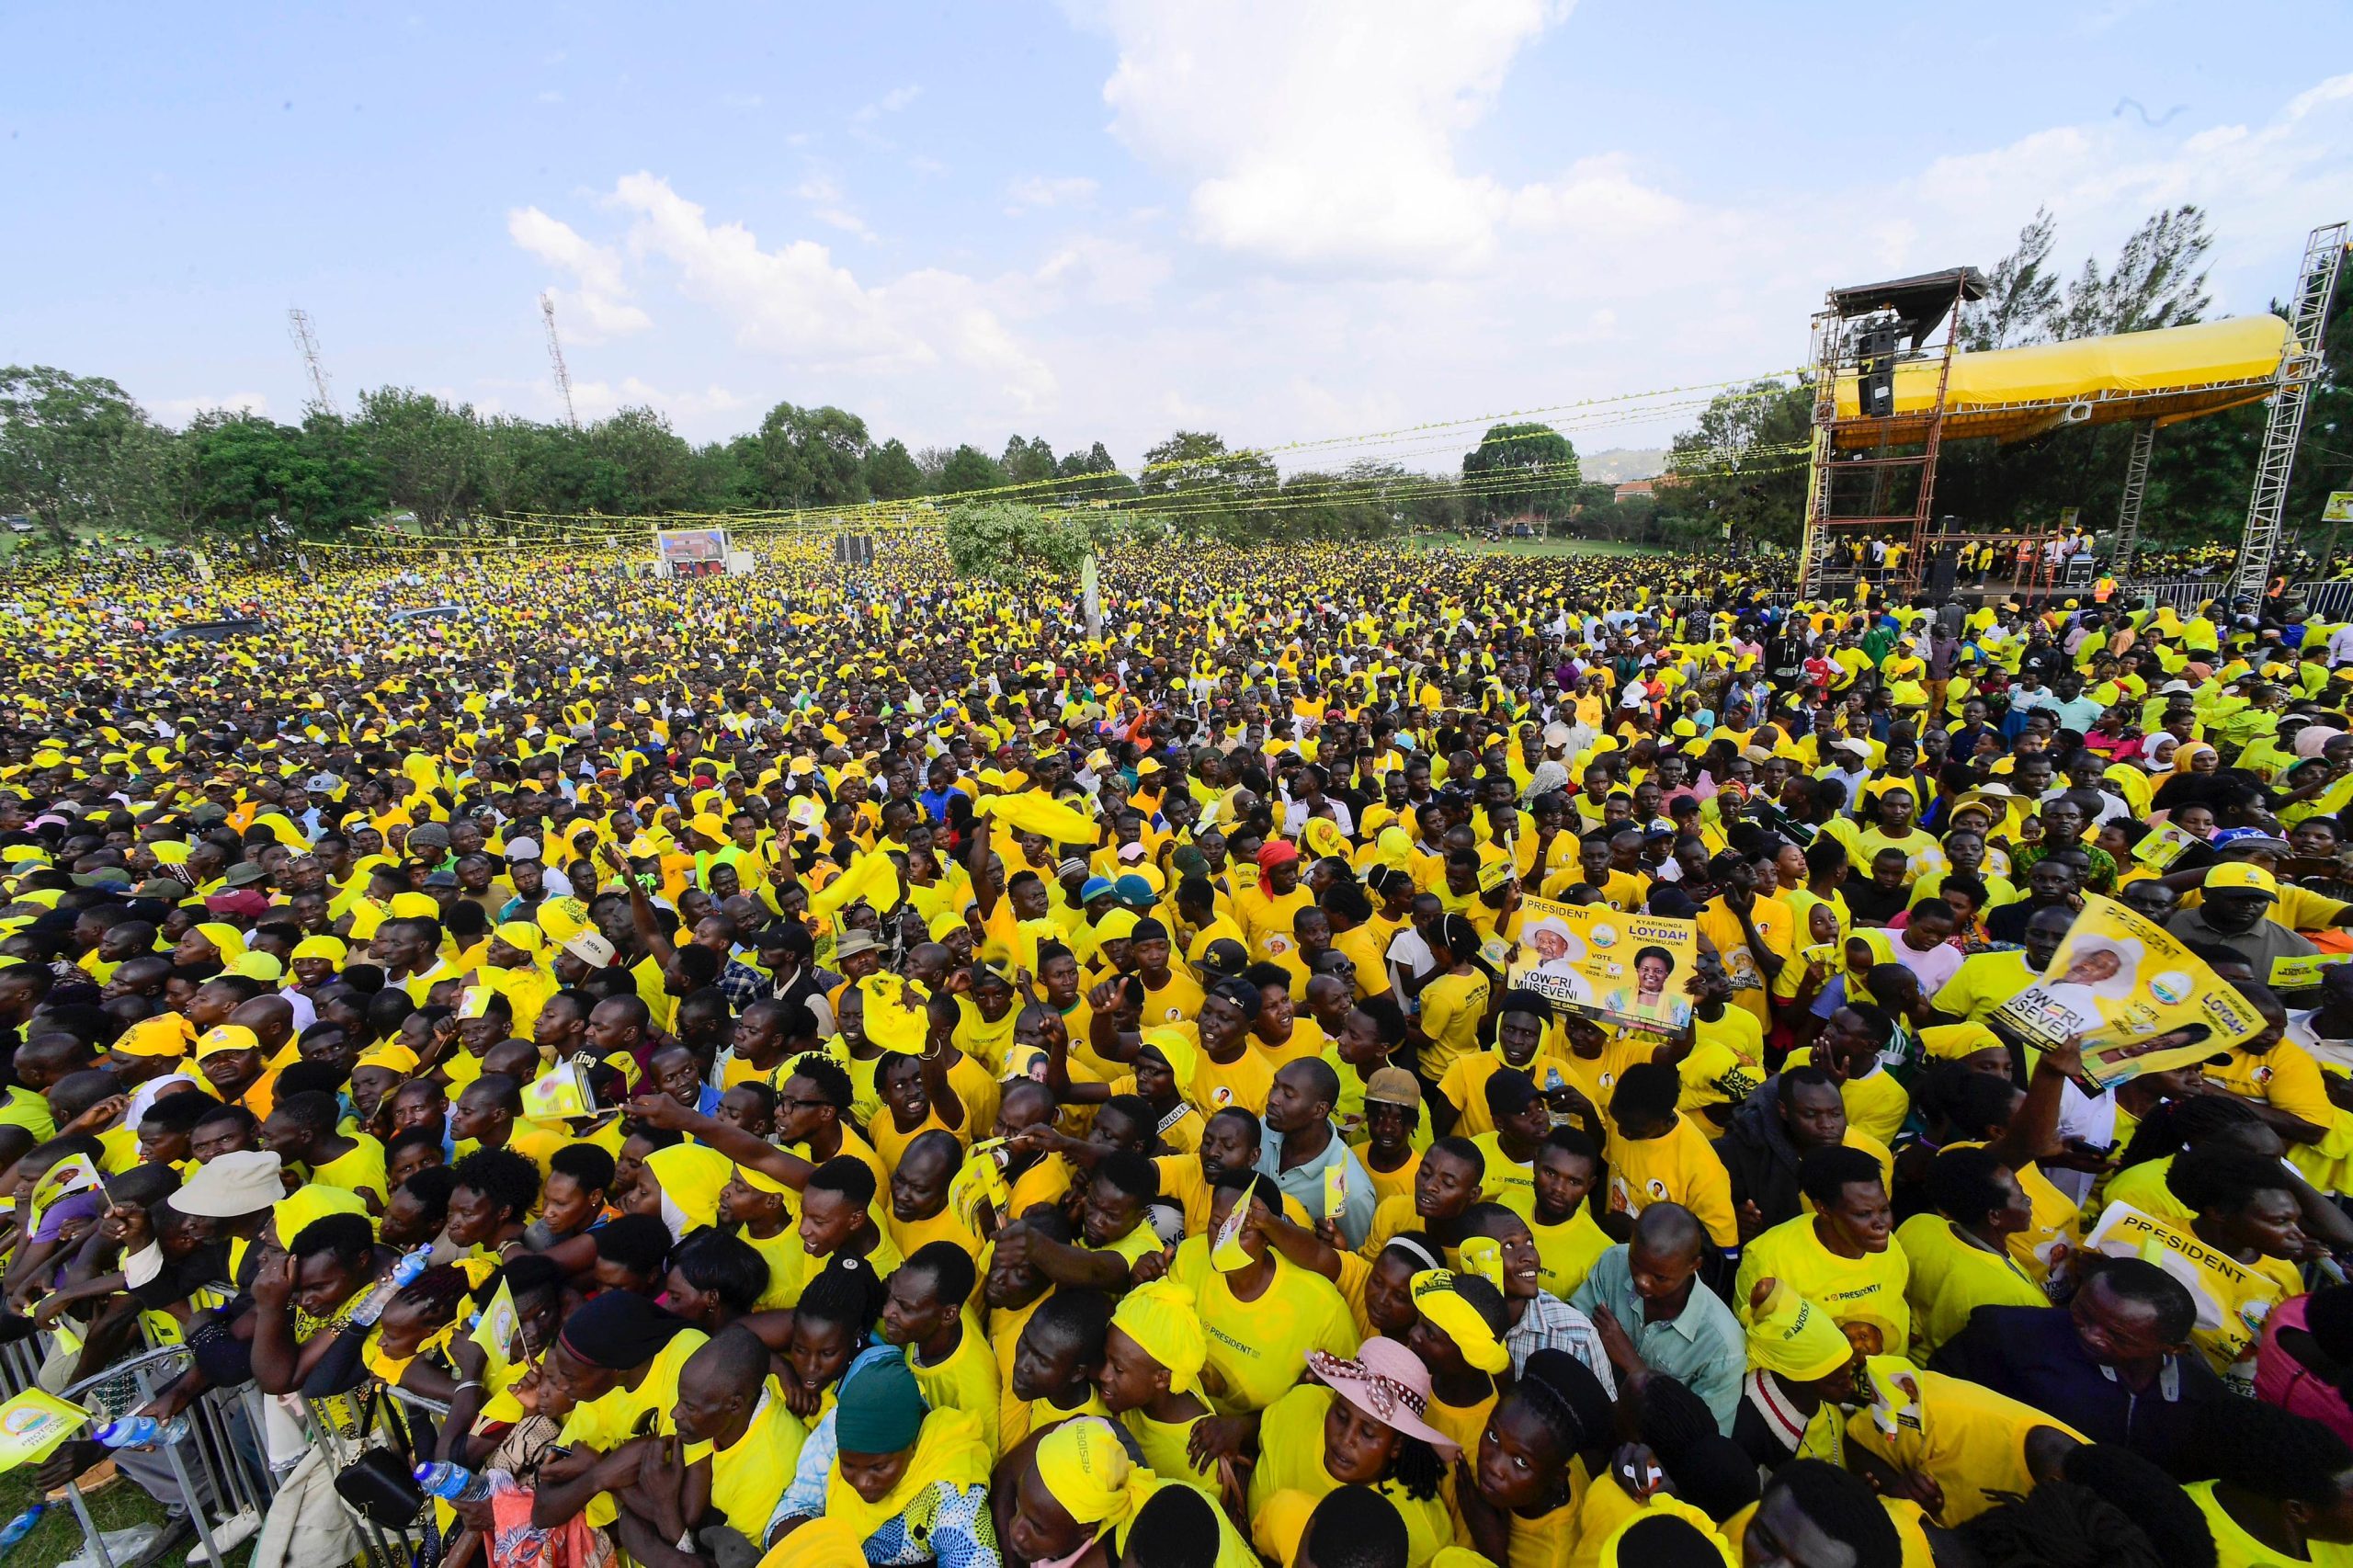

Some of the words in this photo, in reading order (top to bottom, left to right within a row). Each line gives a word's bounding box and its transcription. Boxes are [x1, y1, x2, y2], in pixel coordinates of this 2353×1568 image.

[1527, 900, 1590, 920] PRESIDENT
[1629, 926, 1688, 940] LOYDAH
[1632, 936, 1683, 947] TWINOMUJUNI
[2105, 906, 2181, 960] PRESIDENT
[1591, 952, 1612, 961] VOTE
[1514, 979, 1577, 1000] MUSEVENI
[1523, 971, 1572, 988] YOWERI
[2026, 988, 2085, 1028] OWERI
[2202, 993, 2248, 1036] LOYDAH
[571, 1050, 597, 1069] King
[1504, 1176, 1535, 1187] PRESIDEN
[2123, 1216, 2247, 1284] PRESIDENT
[1839, 1284, 1878, 1301] PRESIDENT
[1790, 1301, 1810, 1335] ESIDENT
[1210, 1326, 1252, 1356] PRESIDENT
[1075, 1424, 1091, 1474] RESIDENT
